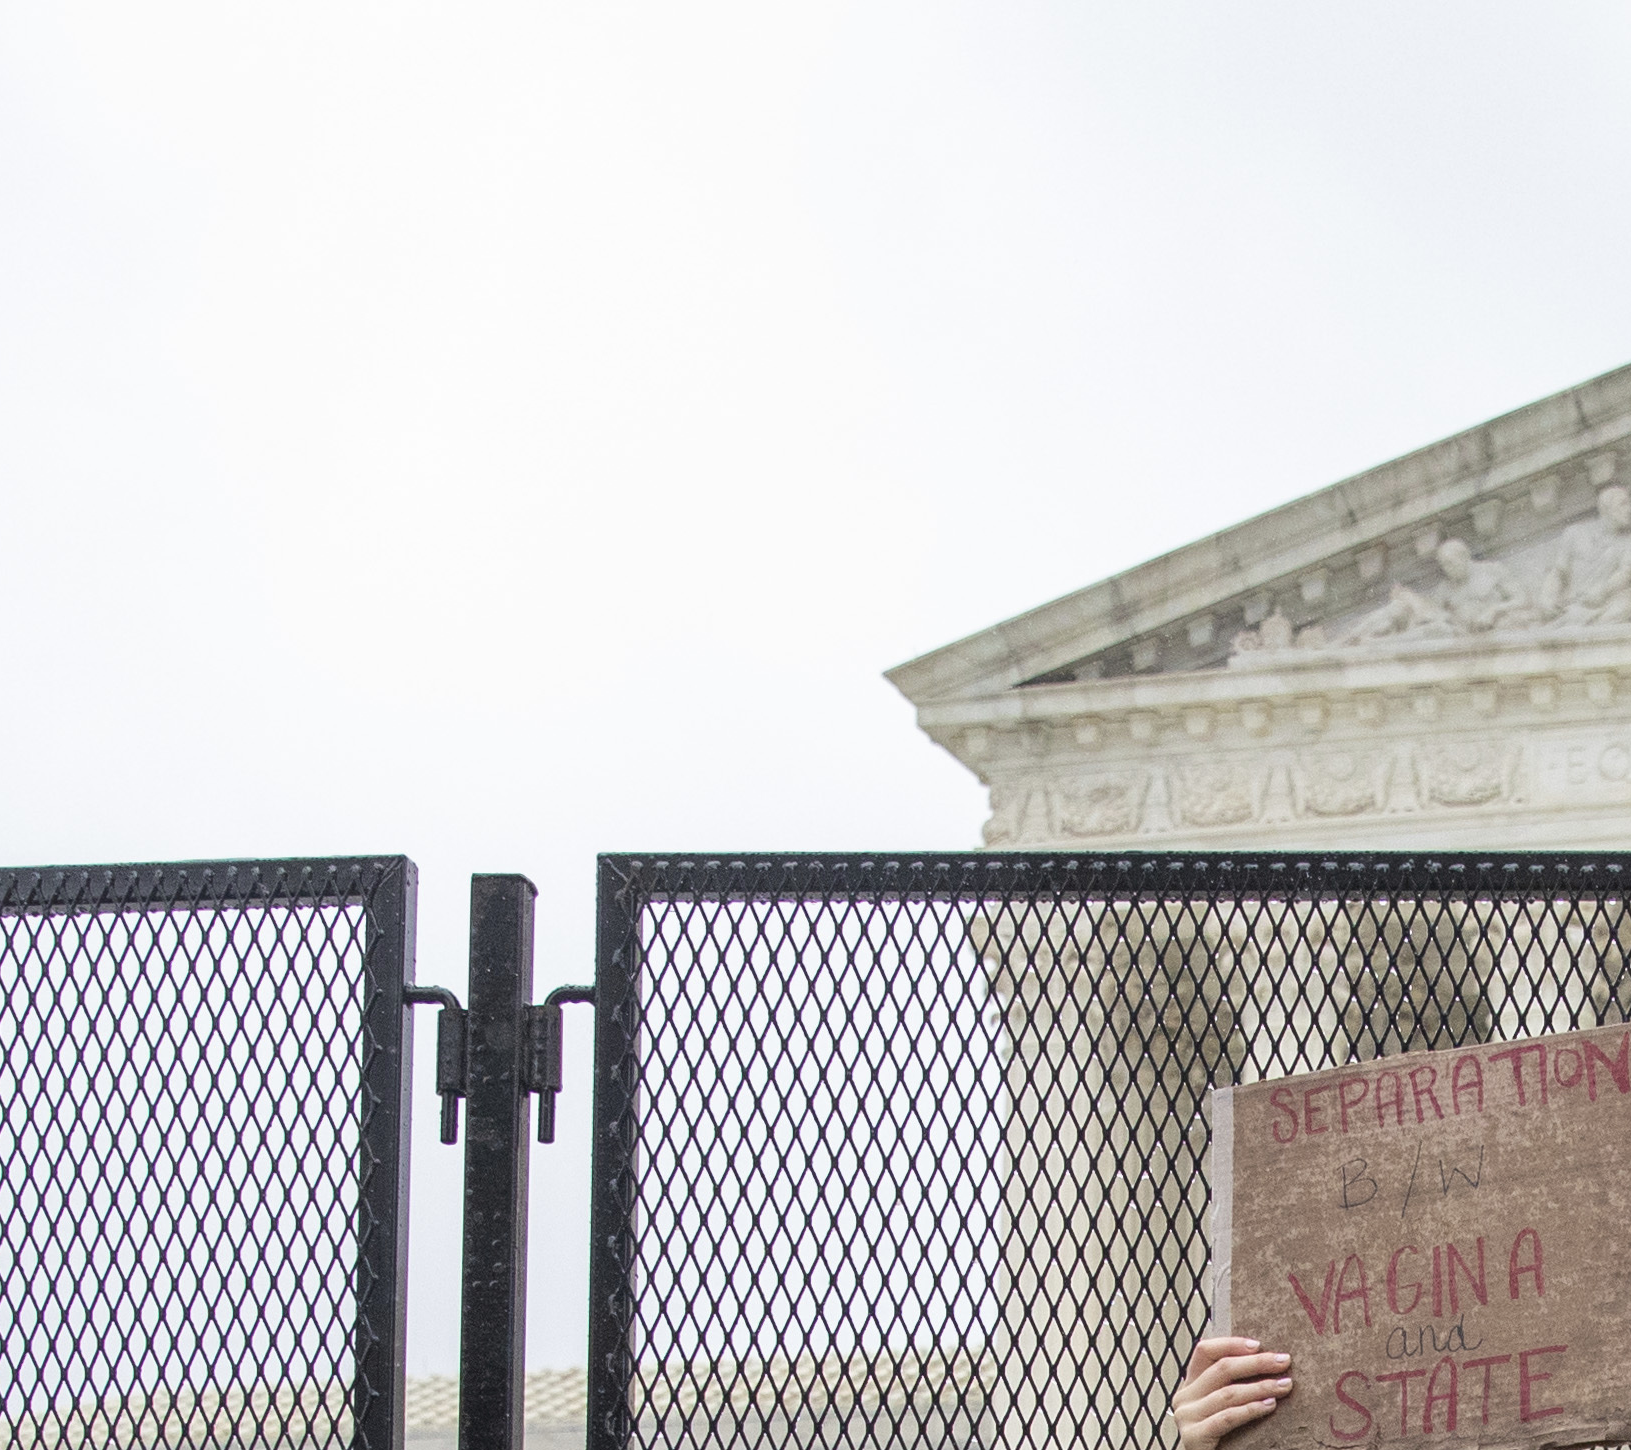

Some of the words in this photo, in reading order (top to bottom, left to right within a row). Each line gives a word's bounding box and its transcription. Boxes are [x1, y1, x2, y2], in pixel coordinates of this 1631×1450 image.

[1268, 1031, 1631, 1144] SEPARATION
[1288, 1227, 1547, 1335] VAGINA
[1385, 1313, 1483, 1361] and
[1329, 1345, 1569, 1442] STATE
